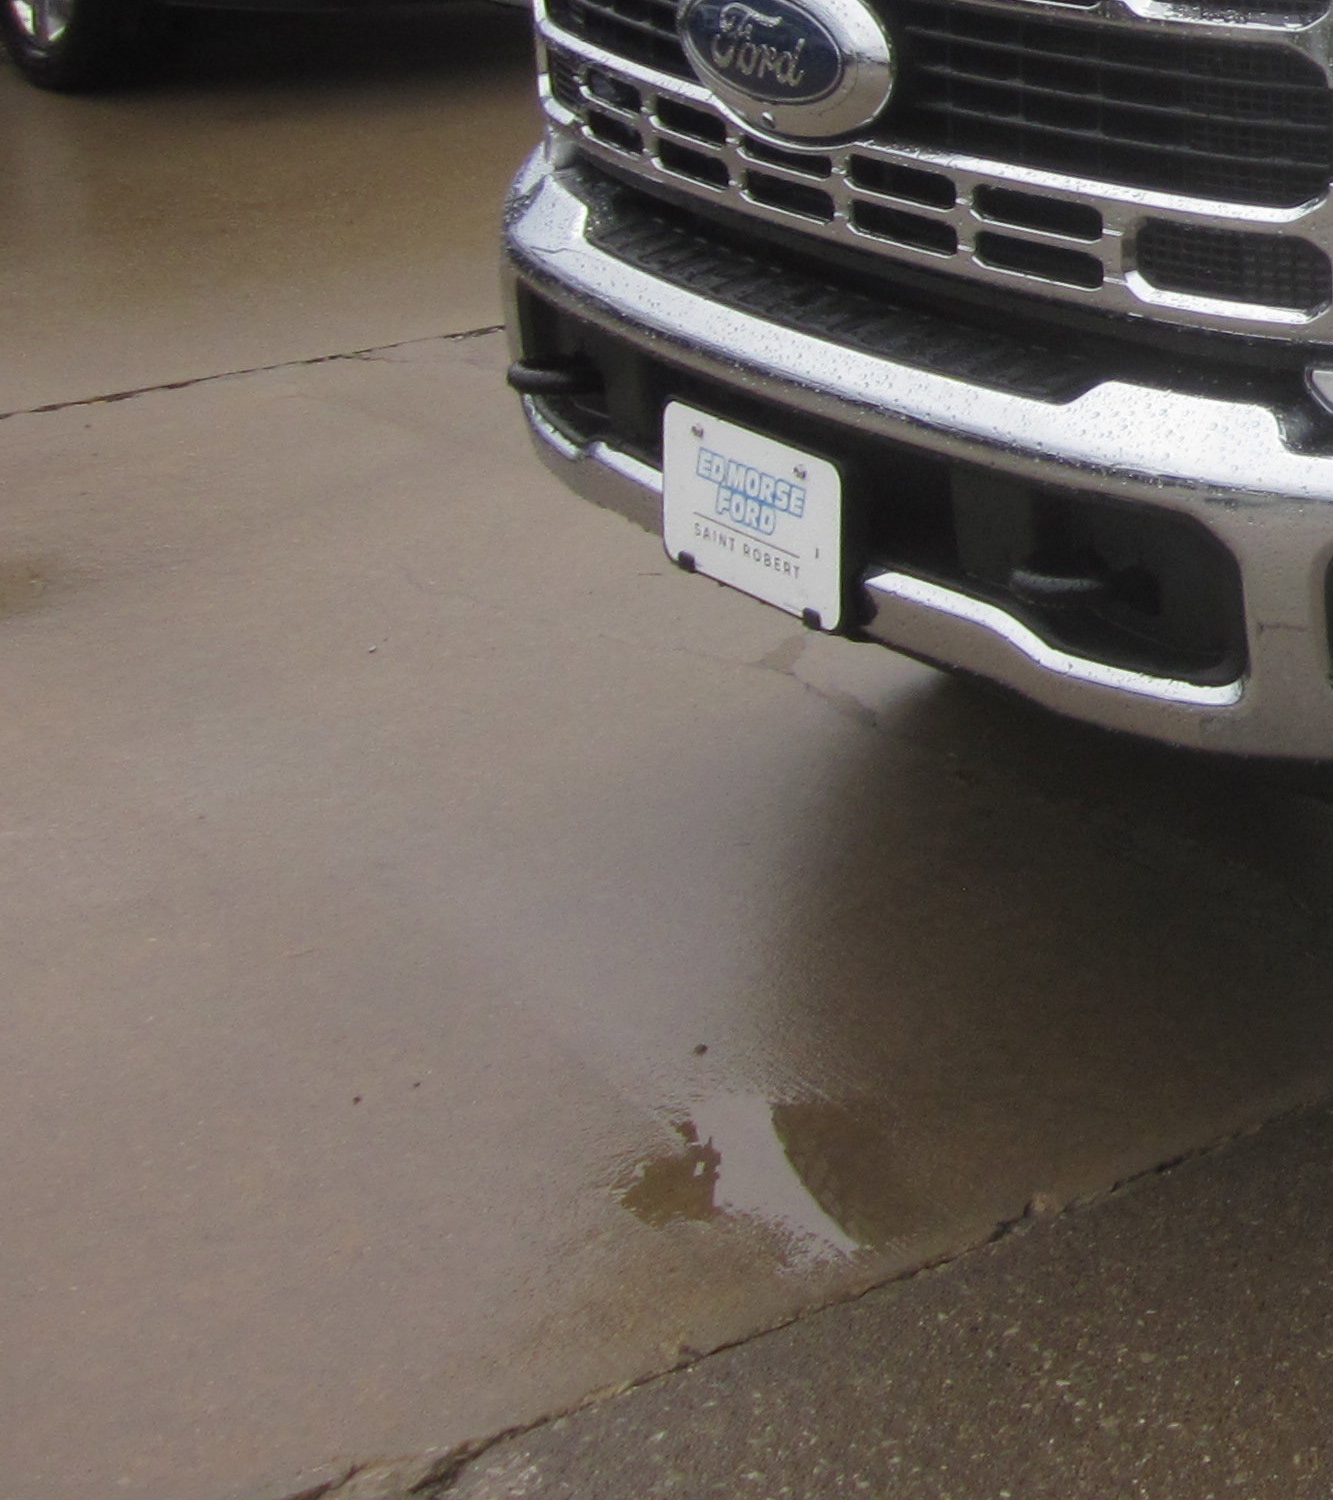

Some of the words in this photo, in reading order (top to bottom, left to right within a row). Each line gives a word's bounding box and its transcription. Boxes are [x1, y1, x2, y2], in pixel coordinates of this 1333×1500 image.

[711, 2, 806, 88] Ford
[696, 447, 725, 485] ED
[726, 459, 806, 518] MORSE
[715, 485, 776, 536] FORD
[693, 521, 735, 552] SAINT
[743, 543, 800, 580] ROBERT
